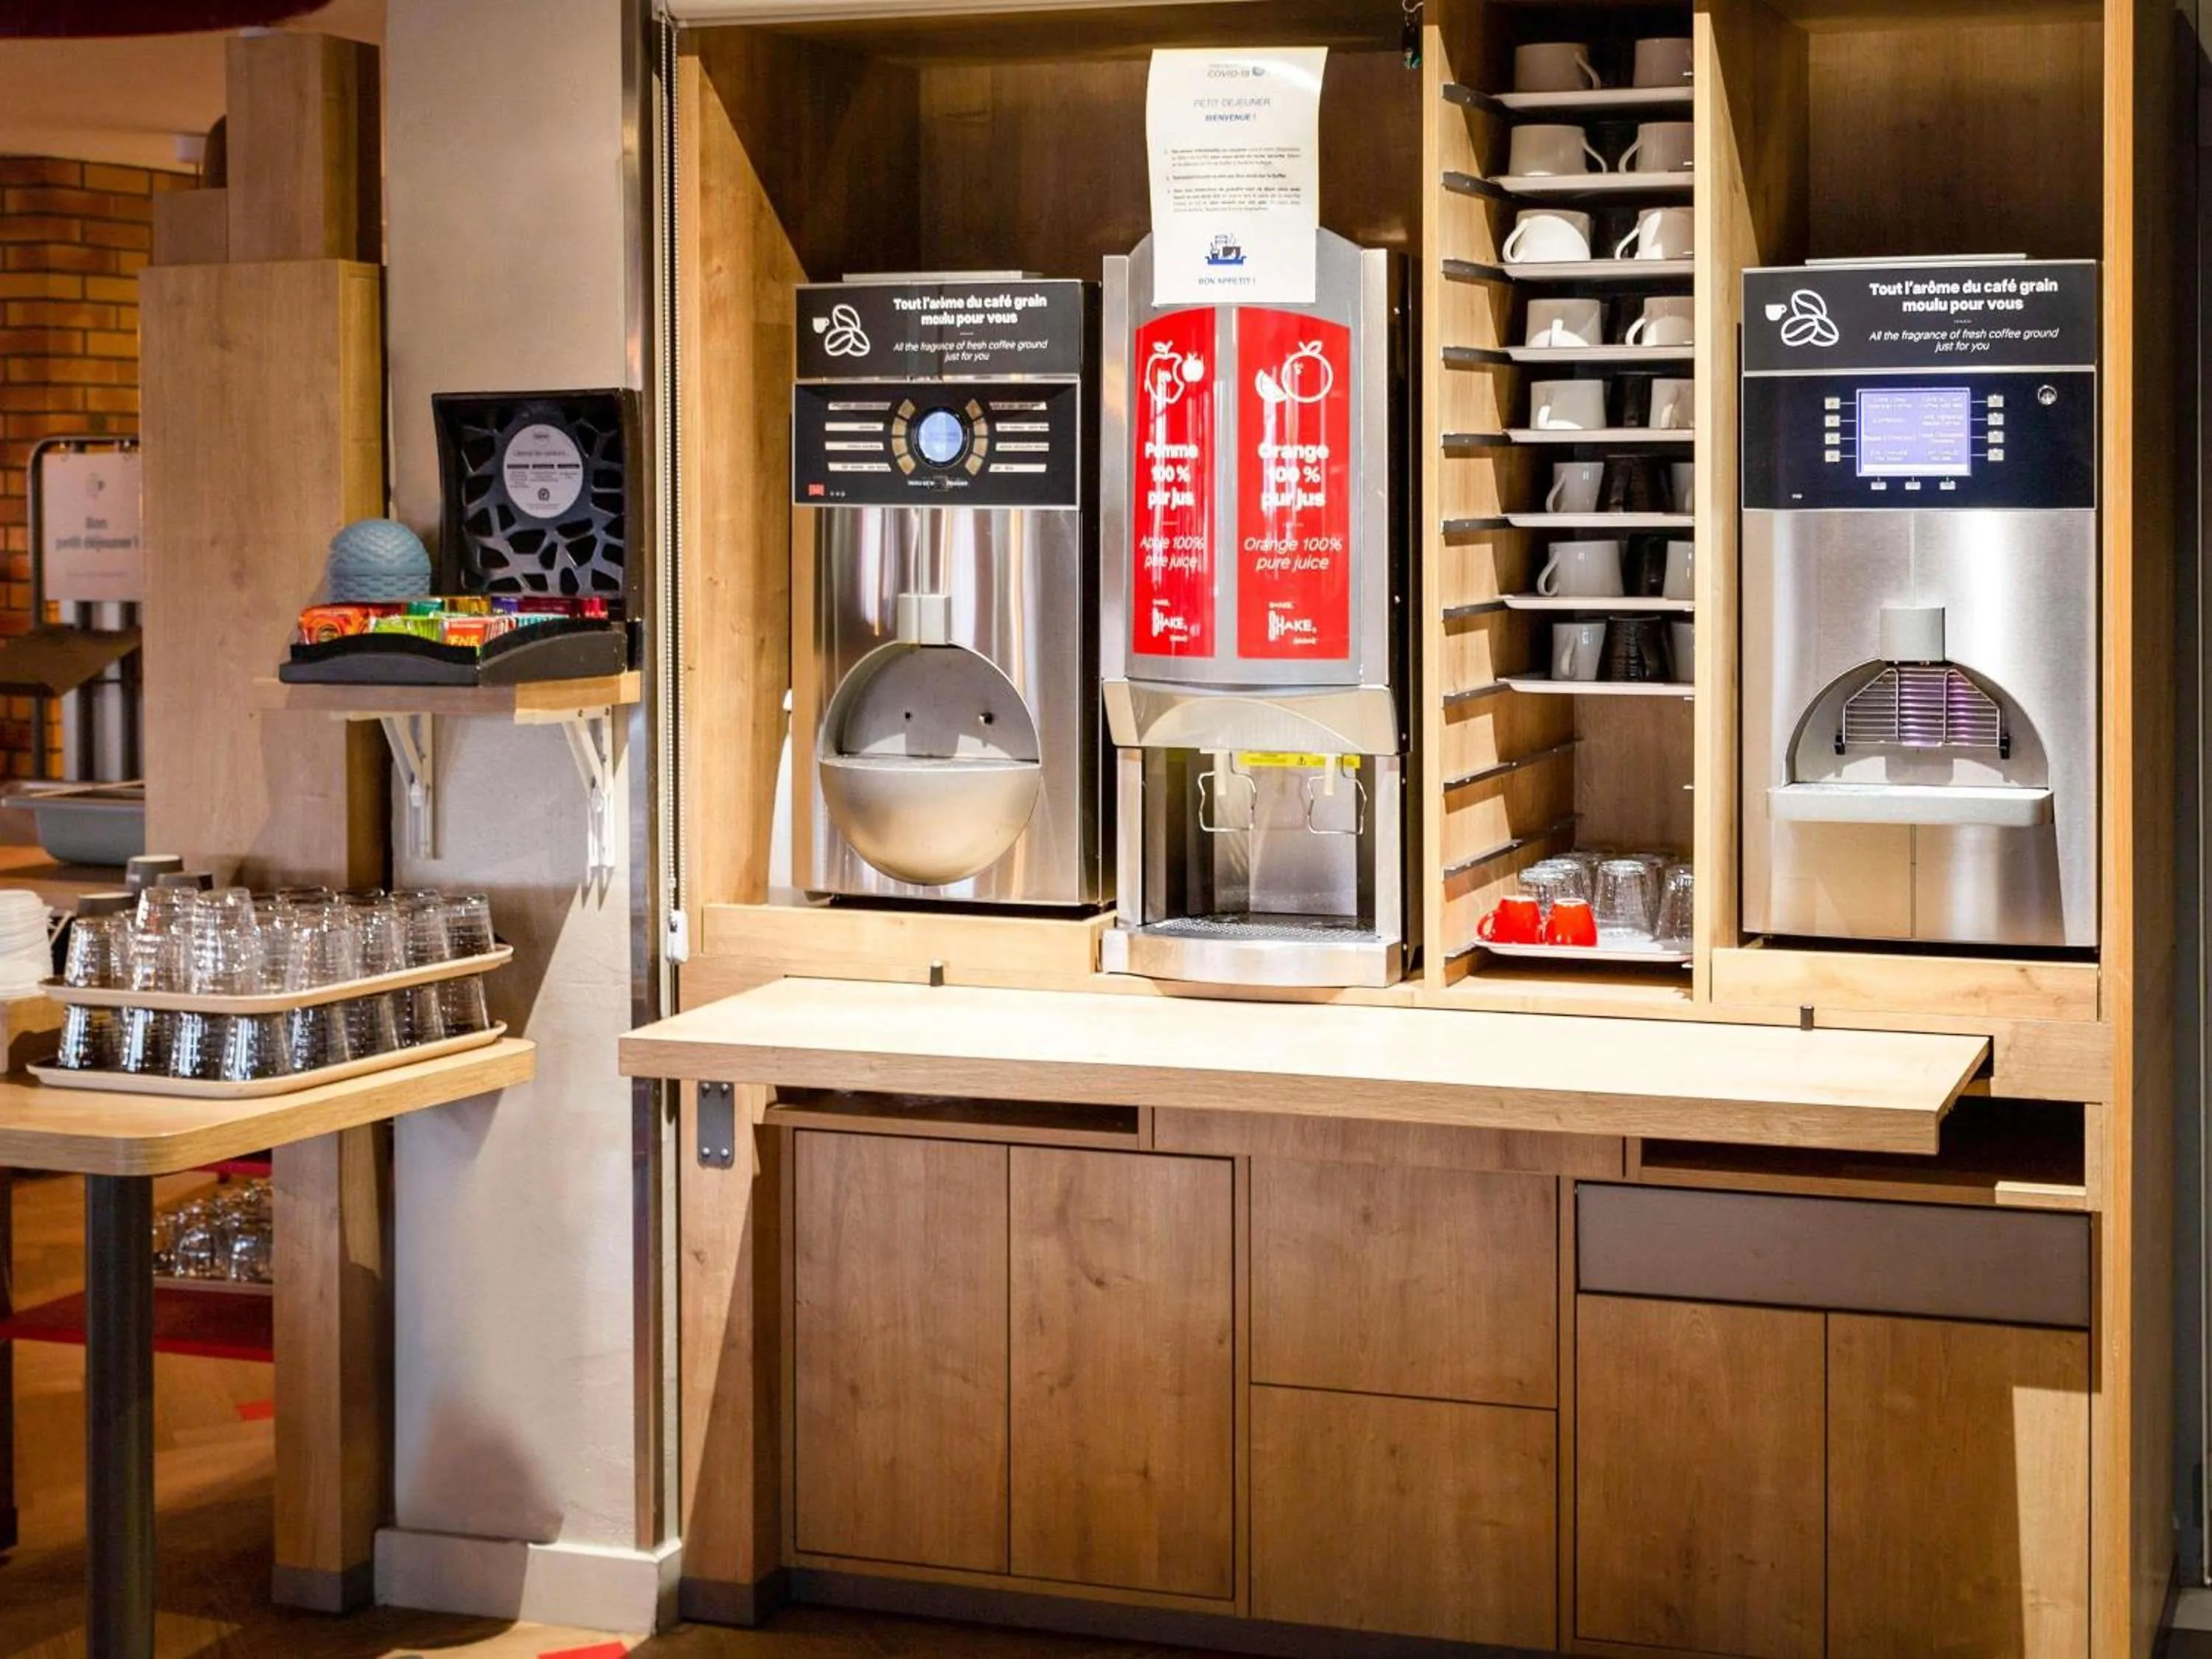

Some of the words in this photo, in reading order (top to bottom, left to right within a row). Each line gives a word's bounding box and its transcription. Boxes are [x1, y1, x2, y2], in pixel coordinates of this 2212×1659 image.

[1869, 282, 1902, 296] Tout
[1962, 279, 1981, 294] du
[1983, 278, 2017, 293] café
[2020, 278, 2059, 295] grain
[893, 297, 922, 310] Tout
[966, 295, 982, 309] du
[984, 293, 1012, 308] café
[1013, 293, 1048, 310] grain
[1902, 297, 1948, 312] moulu
[1950, 299, 1985, 314] pour
[1986, 299, 2024, 311] vous
[956, 313, 985, 327] pour
[987, 312, 1018, 324] vous
[1868, 331, 1882, 341] All
[1884, 330, 1899, 341] the
[1901, 330, 1947, 343] fragrance
[1949, 329, 1961, 340] of
[1961, 329, 1986, 340] fresh
[1988, 328, 2021, 339] coffee
[2023, 327, 2059, 340] ground
[893, 342, 903, 352] All
[905, 341, 919, 352] the
[988, 339, 1016, 350] coffee
[1017, 339, 1048, 352] ground
[1934, 342, 1954, 354] just
[1955, 341, 1970, 352] for
[1971, 342, 1990, 353] you
[944, 352, 959, 364] just
[961, 352, 973, 361] for
[973, 352, 990, 363] you
[1144, 442, 1199, 459] Pomme
[1258, 442, 1329, 464] Orange
[1151, 465, 1175, 482] 100
[1176, 465, 1191, 482] %
[1267, 465, 1301, 483] 100
[1303, 465, 1321, 483] %
[1170, 487, 1195, 511] jus
[1261, 492, 1294, 513] pur
[1295, 488, 1326, 512] jus
[1172, 535, 1205, 551] 100%
[1244, 536, 1298, 554] Orange
[1303, 536, 1343, 552] 100%
[1256, 556, 1290, 571] pure
[1292, 554, 1330, 572] juice
